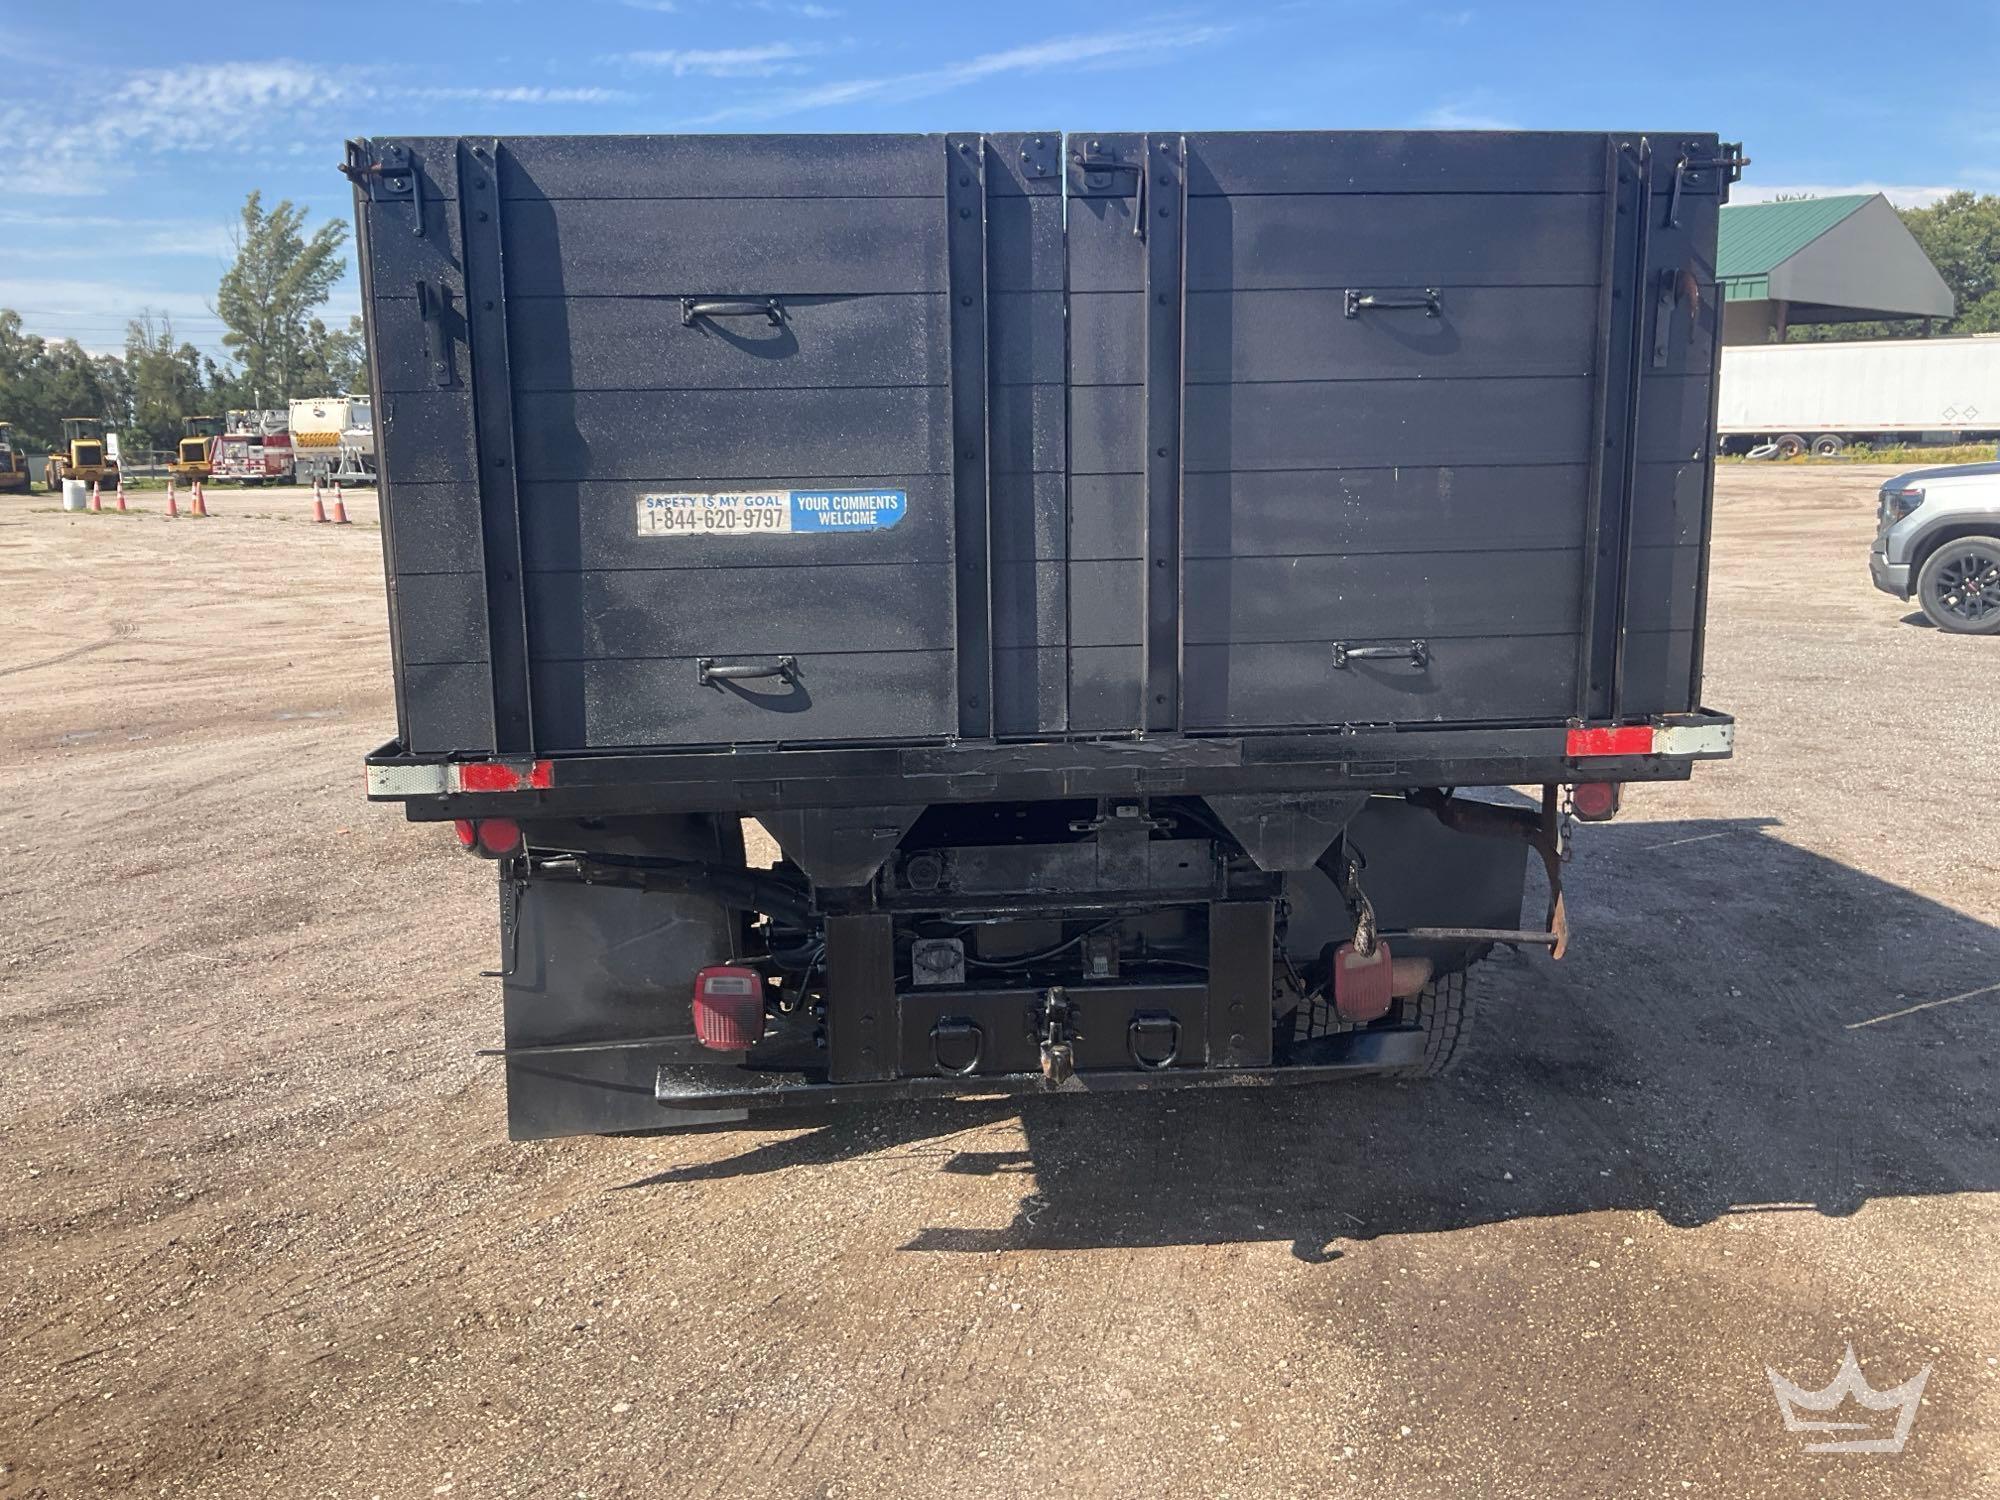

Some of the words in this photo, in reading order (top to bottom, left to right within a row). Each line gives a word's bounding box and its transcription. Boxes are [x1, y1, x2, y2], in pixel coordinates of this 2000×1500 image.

[647, 496, 696, 508] SAFETY
[702, 496, 715, 507] IS
[720, 496, 739, 507] MY
[744, 496, 782, 506] GOAL
[797, 496, 830, 510] YOUR
[833, 495, 898, 510] COMMENTS
[648, 509, 783, 529] 1-844-620-9797
[818, 511, 878, 525] WELCOME
